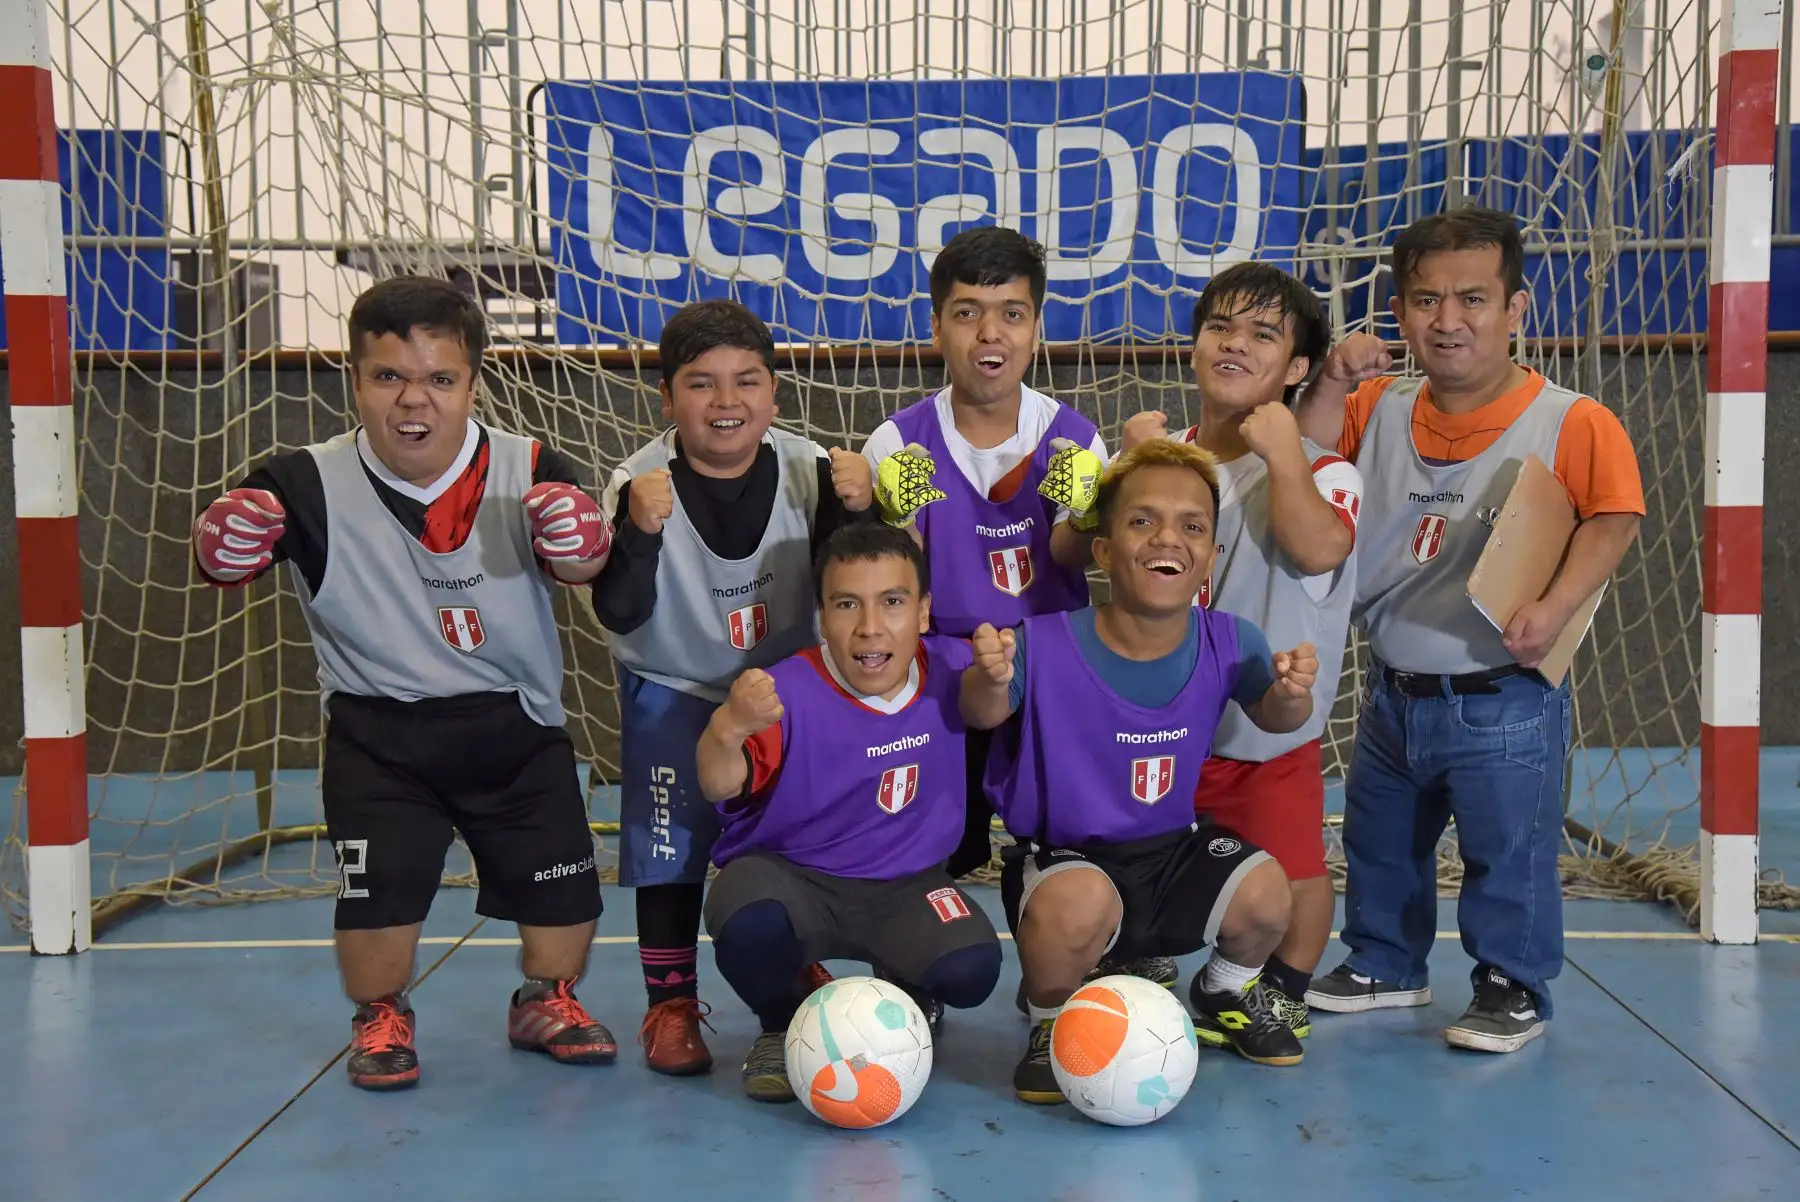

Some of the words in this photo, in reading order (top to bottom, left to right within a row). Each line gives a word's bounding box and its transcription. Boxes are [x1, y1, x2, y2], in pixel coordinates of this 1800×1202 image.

[975, 517, 1035, 538] marathon
[996, 560, 1027, 574] FPF
[421, 572, 484, 590] marathon
[712, 572, 775, 598] marathon
[446, 623, 477, 633] FPF
[734, 618, 763, 636] FPF
[1116, 727, 1188, 744] marathon
[866, 732, 930, 758] marathon
[1137, 771, 1168, 785] FPF
[883, 781, 914, 793] FPF
[1490, 974, 1508, 987] VANS
